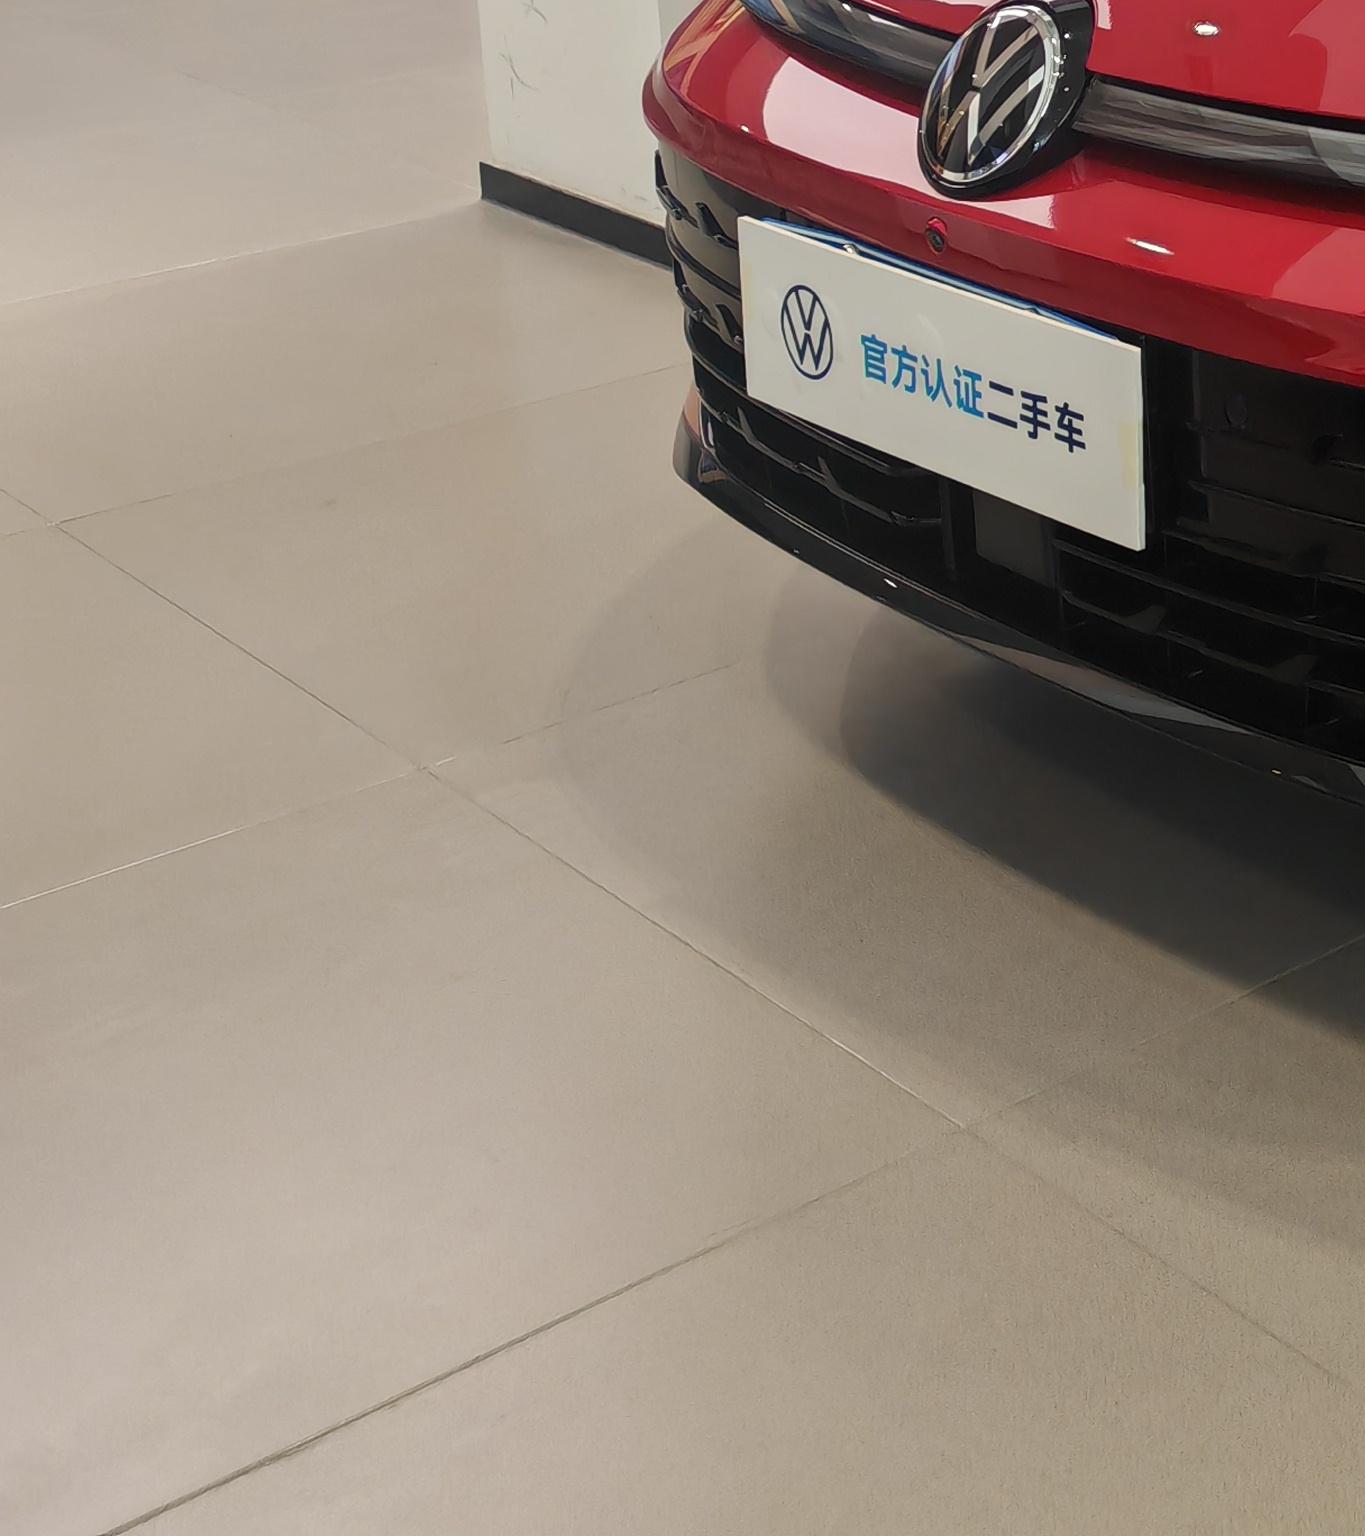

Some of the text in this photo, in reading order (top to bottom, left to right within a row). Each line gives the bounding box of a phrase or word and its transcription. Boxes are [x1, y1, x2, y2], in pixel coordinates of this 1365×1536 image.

[860, 333, 1087, 453] 官方认证二手车
